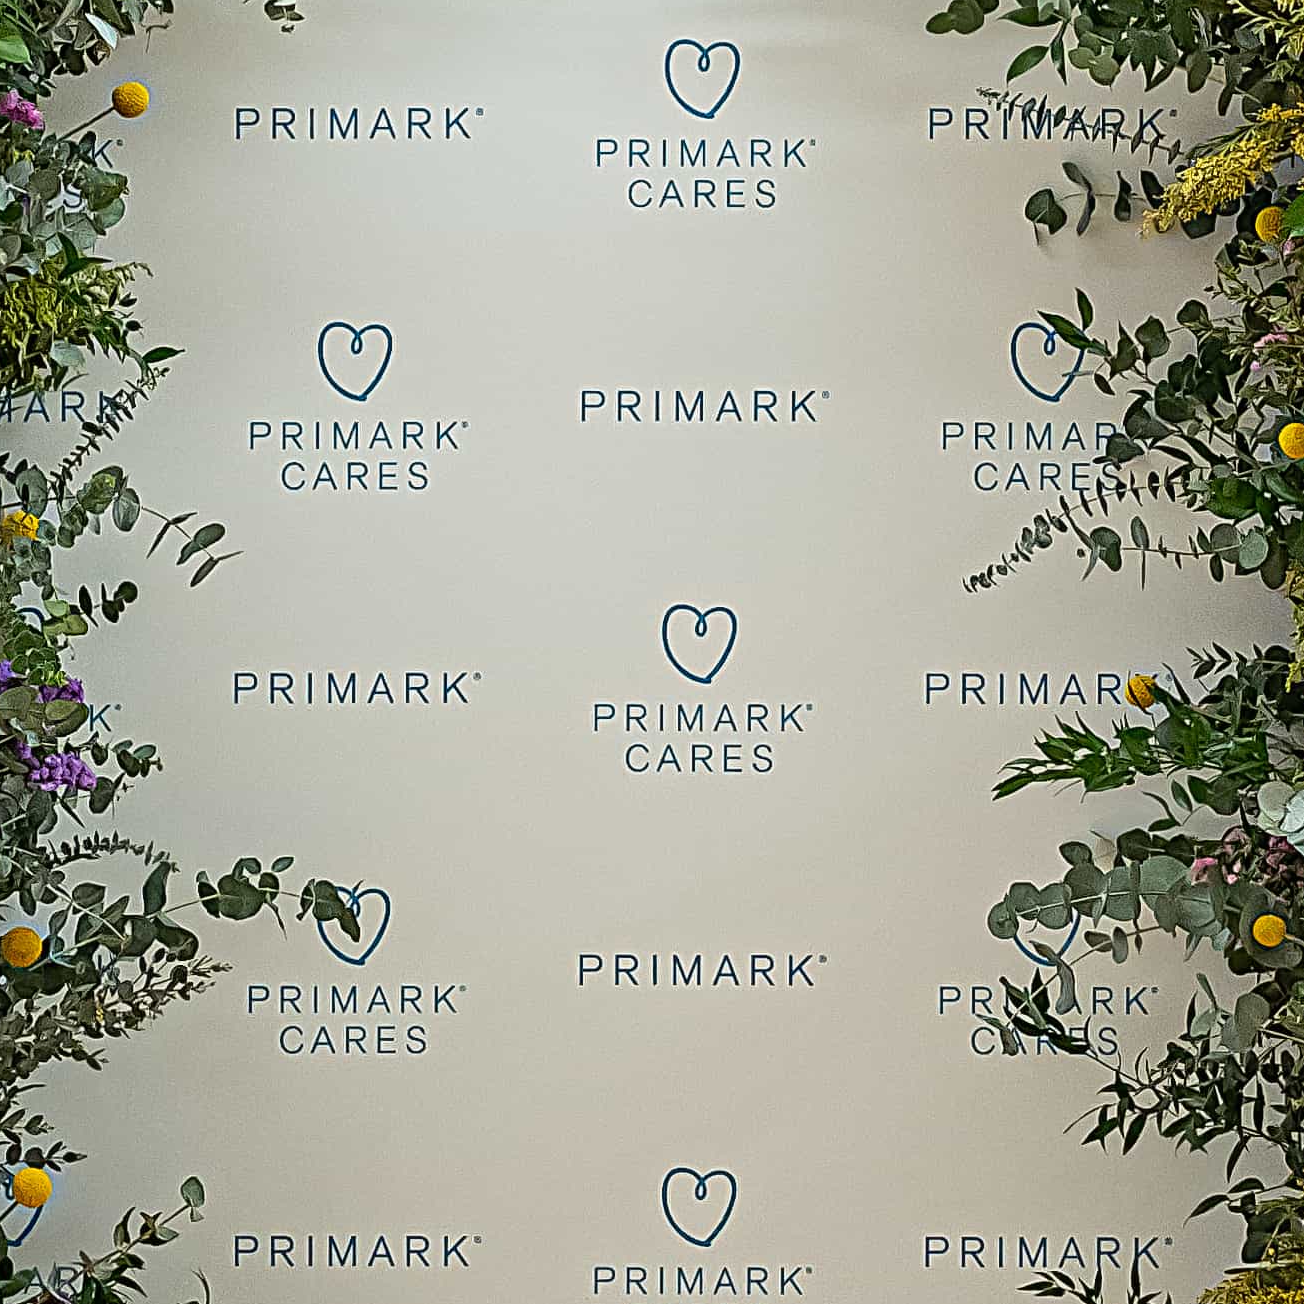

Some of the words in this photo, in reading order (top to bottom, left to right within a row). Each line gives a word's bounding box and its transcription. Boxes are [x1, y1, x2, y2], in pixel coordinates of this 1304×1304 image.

[628, 180, 776, 208] CARES
[942, 422, 1117, 450] PRIMAR
[282, 462, 429, 490] CARES
[974, 462, 1121, 491] CARES
[926, 674, 1157, 704] PRIMAR
[626, 744, 773, 772] CARES
[940, 986, 1148, 1014] PRRK
[280, 1026, 427, 1054] CARES
